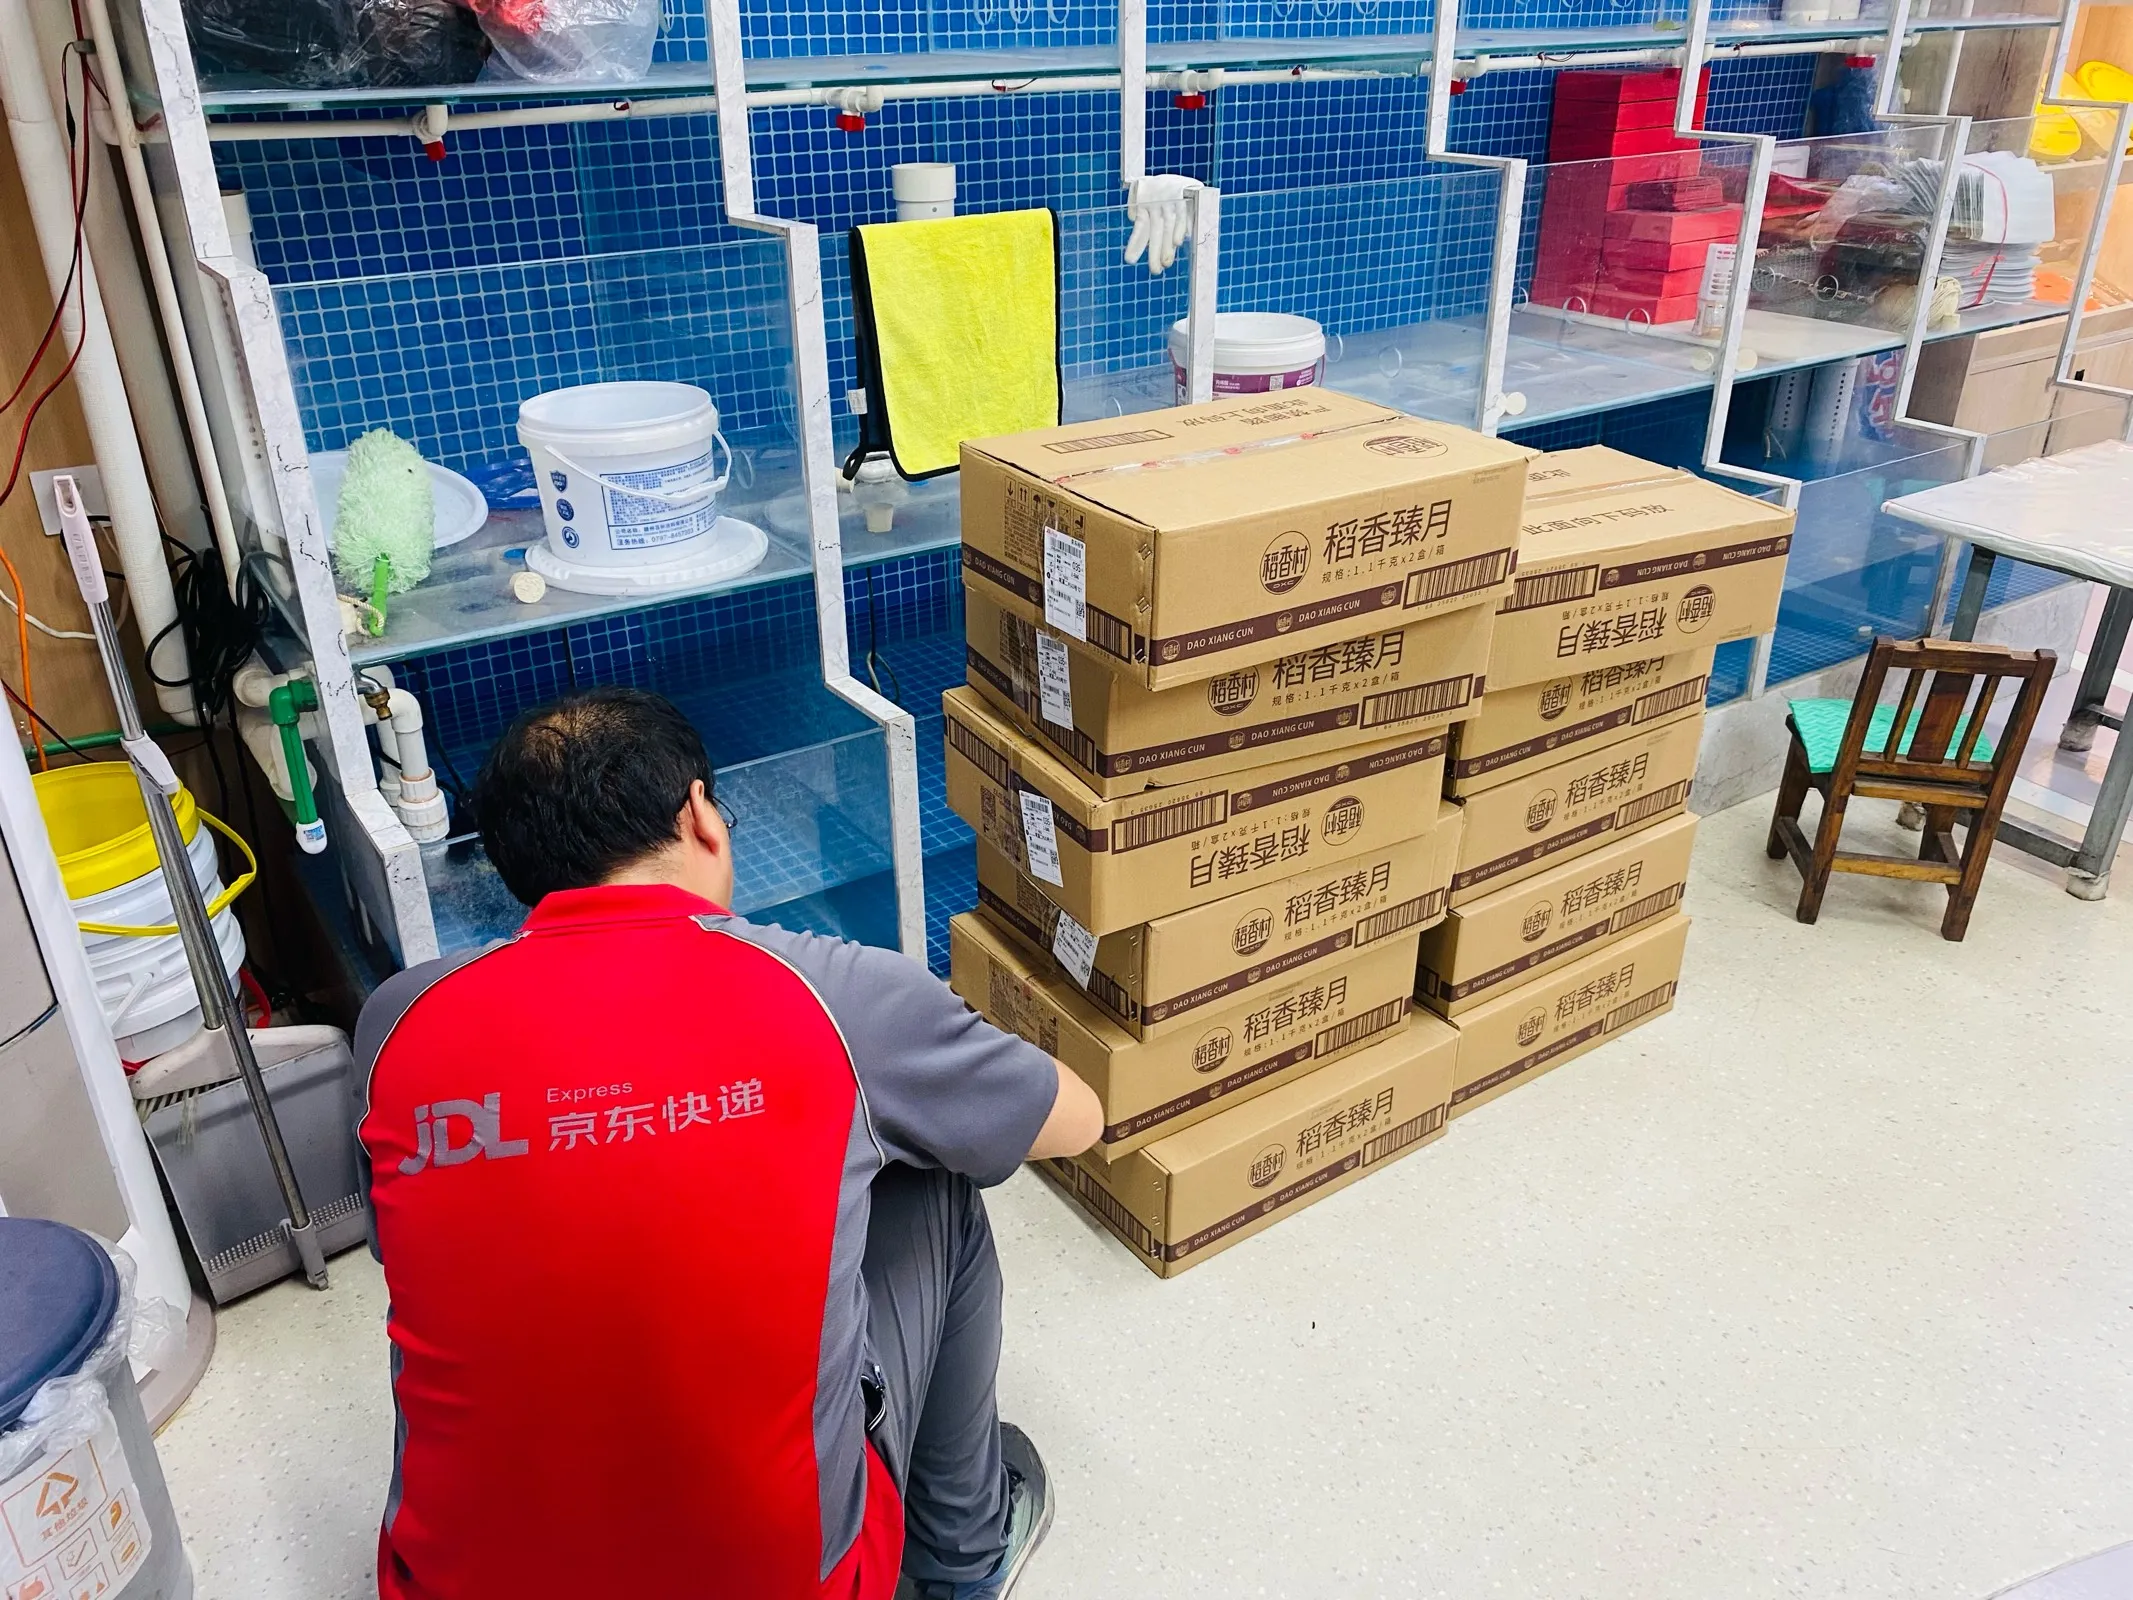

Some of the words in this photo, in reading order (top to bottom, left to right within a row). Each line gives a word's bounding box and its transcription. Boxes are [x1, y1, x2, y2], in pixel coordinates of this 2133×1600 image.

[1322, 499, 1453, 565] 稻香臻月
[1522, 504, 1674, 536] 此面向下码放
[1262, 544, 1309, 582] 稻香村
[1321, 544, 1445, 584] 规格:1.1千克x2盒/箱
[1722, 551, 1737, 561] CUN
[1737, 547, 1757, 558] XIANG
[1757, 545, 1772, 554] DAO
[1637, 567, 1652, 577] CUN
[1652, 563, 1673, 574] XIANG
[1673, 560, 1689, 570] DAO
[1273, 579, 1296, 589] DXC
[1298, 610, 1317, 623] DAO
[1317, 603, 1342, 618] XIANG
[1343, 599, 1361, 611] CUN
[1677, 595, 1714, 624] 稻香村
[1187, 638, 1206, 651] DAO
[1208, 631, 1235, 645] XIANG
[1236, 626, 1254, 639] CUN
[1556, 606, 1668, 659] 稻香臻月
[1271, 631, 1405, 690] 稻香臻月
[1210, 672, 1257, 705] 稻香村
[1272, 671, 1400, 707] 规格:1.1千克x2盒/箱
[1539, 683, 1572, 712] 稻香村
[1251, 729, 1269, 741] DAO
[1270, 724, 1296, 736] XIANG
[1297, 720, 1314, 731] CUN
[1139, 753, 1158, 764] DAO
[1160, 747, 1186, 760] XIANG
[1187, 743, 1206, 754] CUN
[1368, 758, 1384, 769] CUN
[1384, 752, 1407, 765] XIANG
[1407, 748, 1423, 758] DAO
[1485, 757, 1499, 767] DAO
[1499, 750, 1518, 762] XIANG
[1518, 745, 1532, 756] CUN
[1272, 785, 1289, 797] CUN
[1290, 778, 1313, 792] XIANG
[1314, 773, 1330, 785] DAO
[1564, 752, 1650, 809] 稻香臻月
[1323, 805, 1362, 837] 稻香村
[1525, 796, 1557, 826] 稻香村
[1190, 823, 1311, 889] 稻香臻月
[1283, 861, 1391, 928] 稻香臻月
[1560, 860, 1644, 918] 稻香臻月
[1233, 915, 1272, 949] 稻香村
[1265, 962, 1281, 974] DAO
[1281, 953, 1303, 967] XIANG
[1303, 947, 1318, 958] CUN
[1173, 998, 1189, 1010] DAO
[1190, 989, 1213, 1003] XIANG
[1213, 982, 1229, 994] CUN
[1554, 962, 1635, 1022] 稻香臻月
[1242, 975, 1348, 1044] 稻香臻月
[1194, 1034, 1231, 1067] 稻香村
[1227, 1076, 1242, 1088] DAO
[1242, 1066, 1263, 1081] XIANG
[1263, 1060, 1278, 1072] CUN
[546, 1081, 633, 1103] Express
[547, 1077, 765, 1152] 京东快递
[1137, 1115, 1153, 1127] DAO
[1154, 1105, 1175, 1120] XIANG
[1176, 1098, 1191, 1110] CUN
[1295, 1086, 1395, 1158] 稻香臻月
[398, 1092, 529, 1176] JDL
[1249, 1149, 1285, 1184] 稻香村
[1279, 1189, 1294, 1202] DAO
[1294, 1179, 1314, 1194] XIANG
[1314, 1172, 1328, 1183] CUN
[1194, 1233, 1209, 1245] DAO
[1210, 1222, 1231, 1237] XIANG
[1231, 1214, 1246, 1226] CUN
